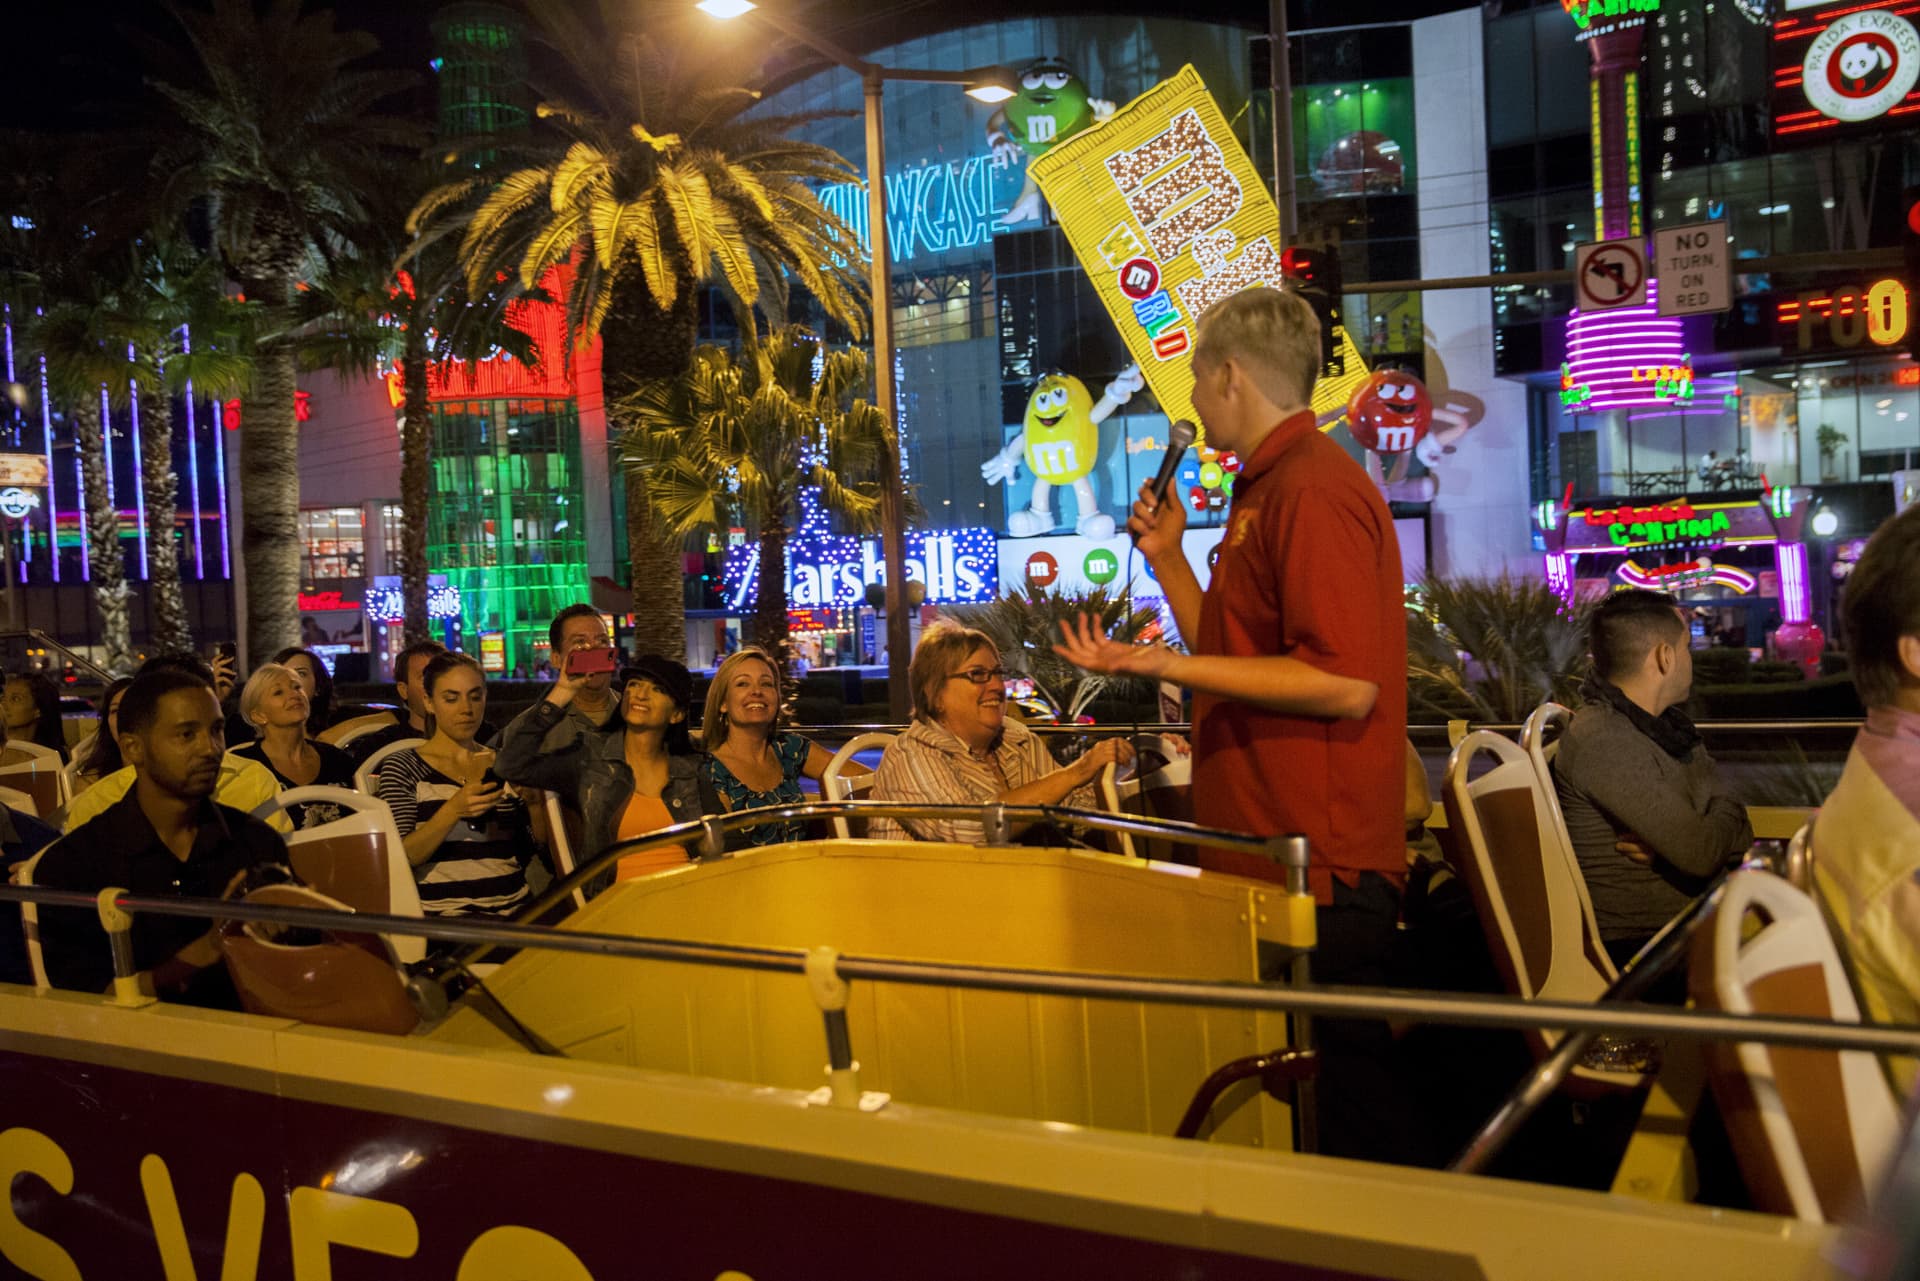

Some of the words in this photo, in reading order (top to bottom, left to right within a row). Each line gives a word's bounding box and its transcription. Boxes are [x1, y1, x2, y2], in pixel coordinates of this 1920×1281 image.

[1809, 22, 1851, 71] PANDA
[1860, 14, 1917, 54] EXPRESS
[1676, 232, 1709, 251] NO
[1671, 254, 1713, 271] TURN
[1681, 274, 1704, 289] ON
[1676, 292, 1710, 308] RED
[1798, 279, 1908, 351] FOO
[1608, 511, 1731, 546] CANTINA
